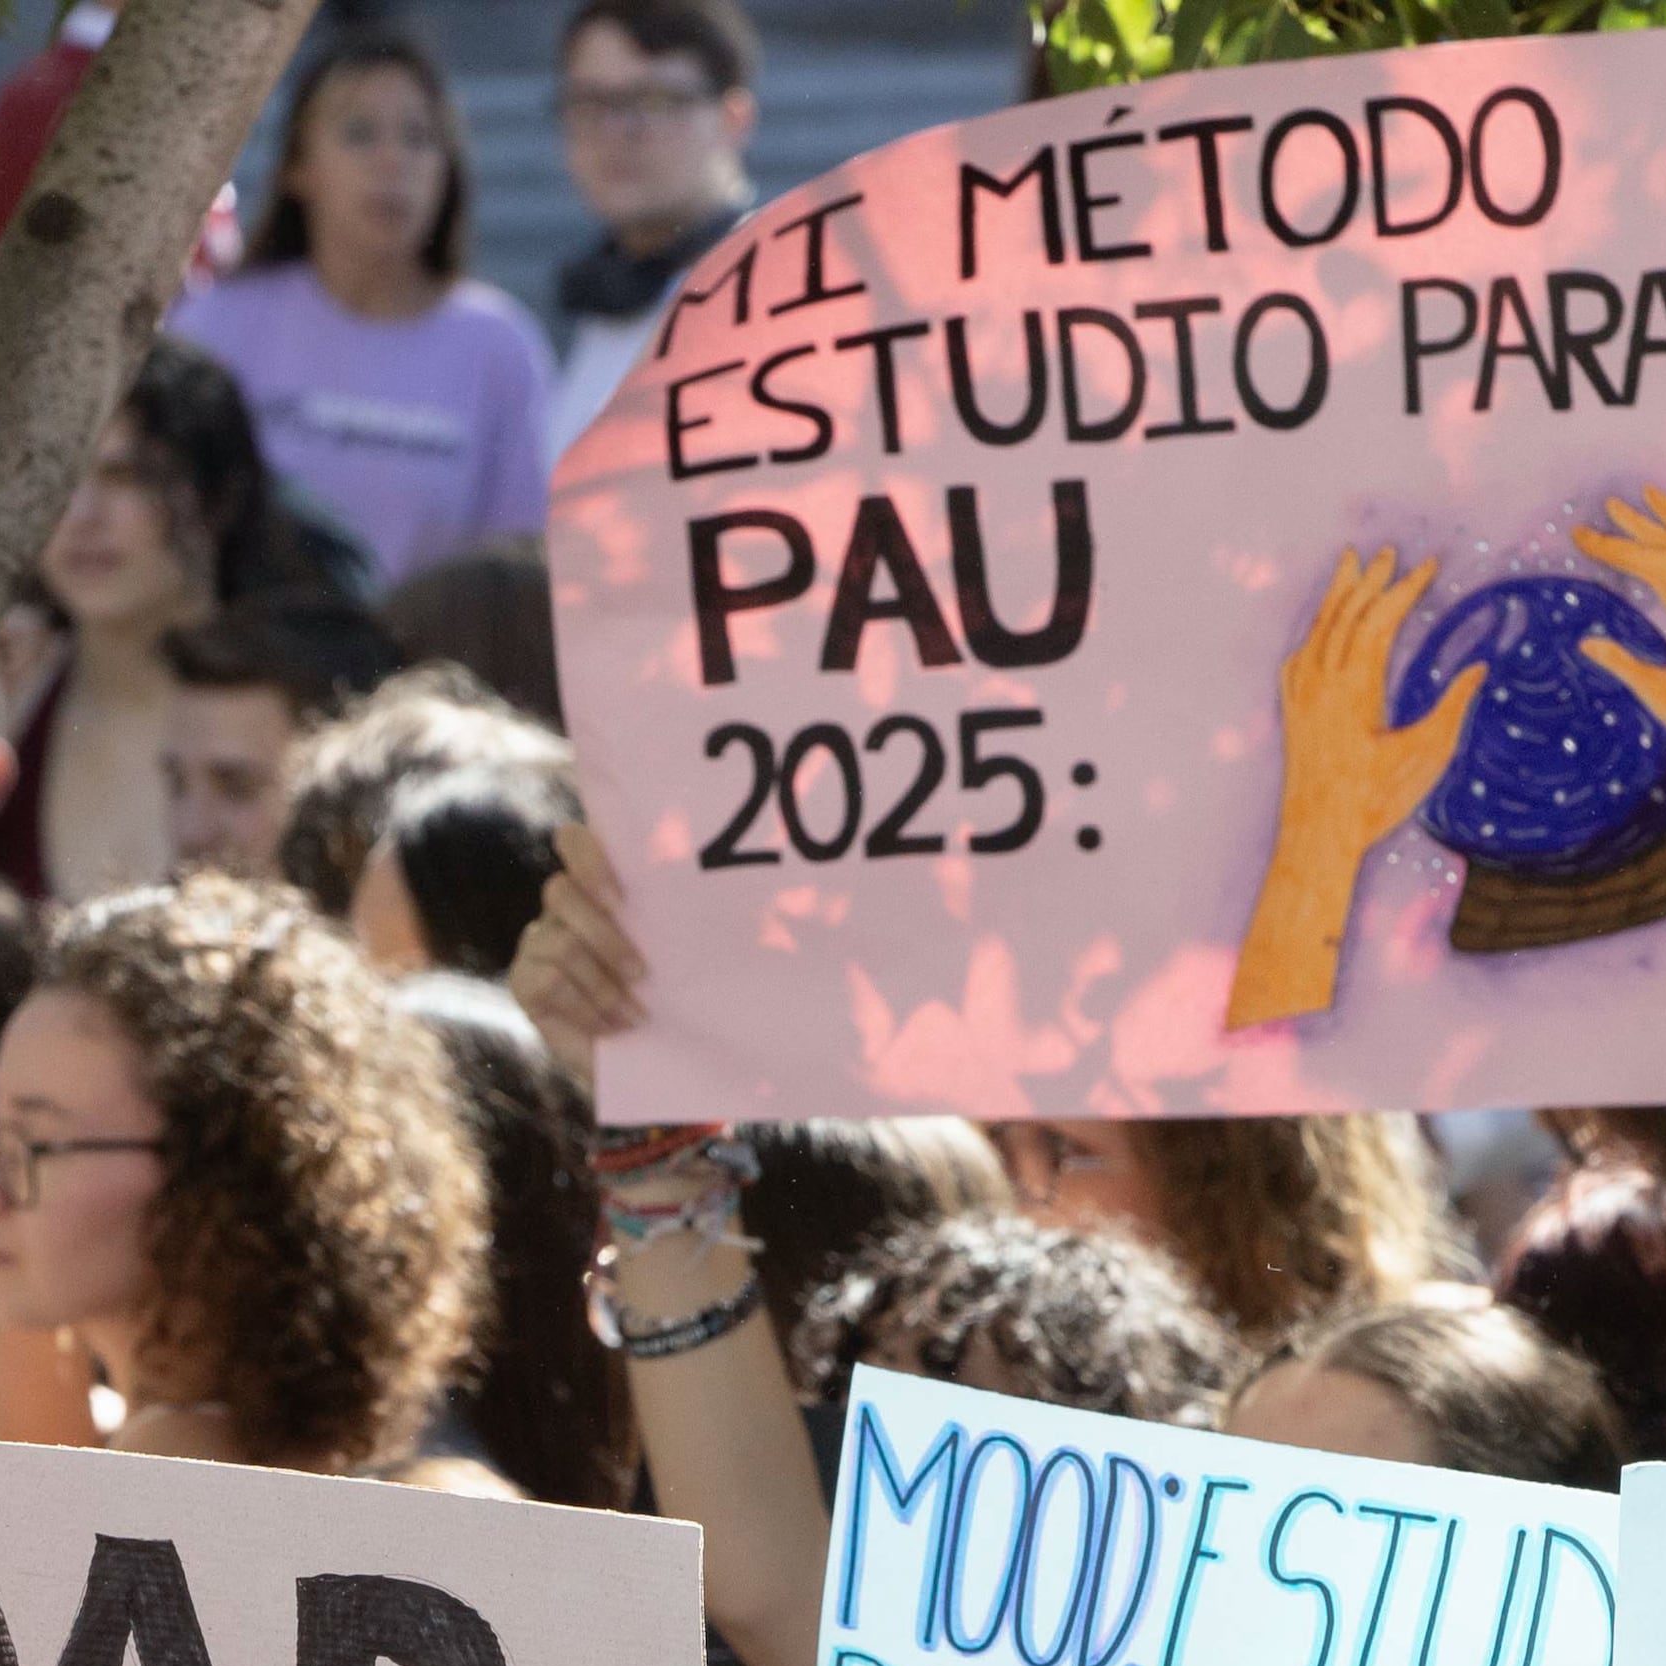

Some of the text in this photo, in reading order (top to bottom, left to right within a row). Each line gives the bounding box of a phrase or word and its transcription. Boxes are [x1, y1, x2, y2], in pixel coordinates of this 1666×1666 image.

[655, 193, 864, 360] MI
[960, 86, 1562, 280] MÉTODO
[667, 292, 1328, 481] ESTUDIO
[687, 480, 1094, 686] PAU
[699, 707, 1102, 870] 2025:
